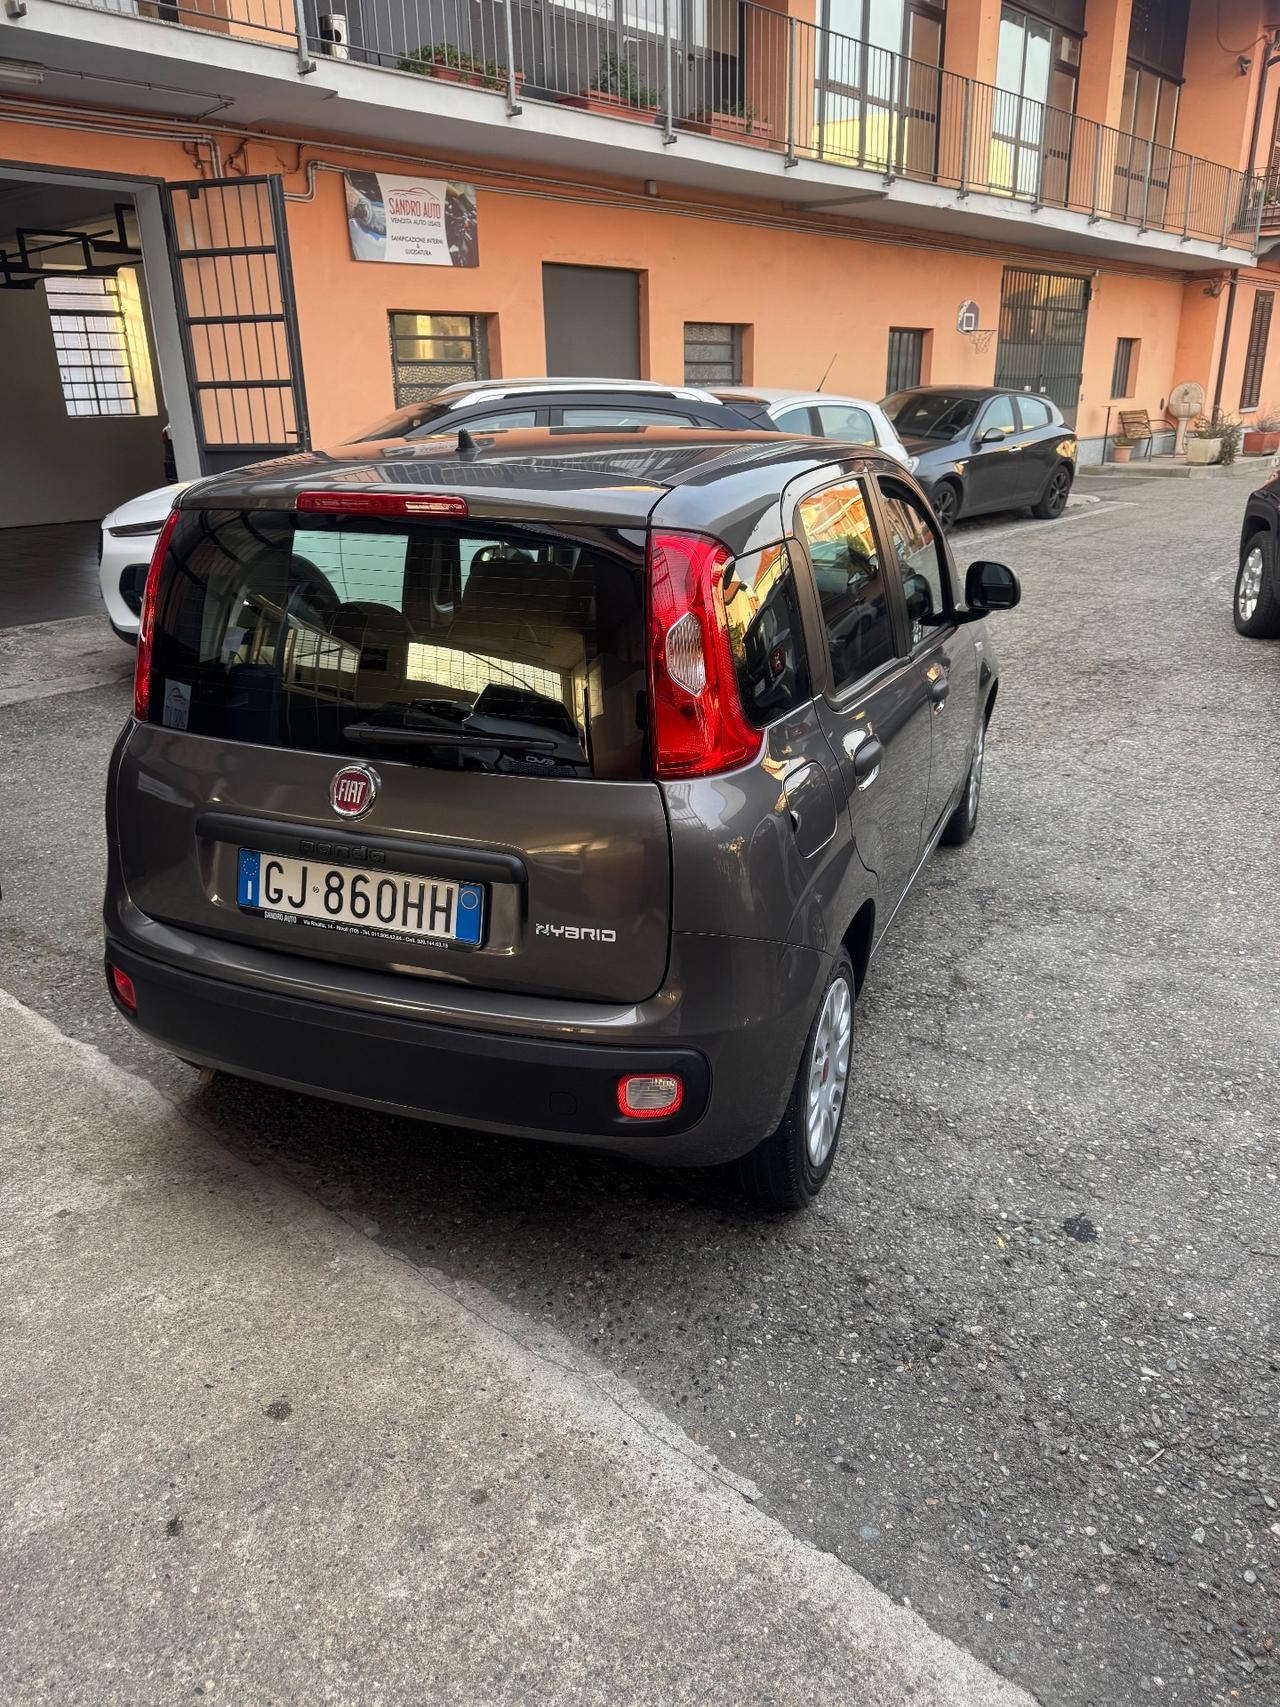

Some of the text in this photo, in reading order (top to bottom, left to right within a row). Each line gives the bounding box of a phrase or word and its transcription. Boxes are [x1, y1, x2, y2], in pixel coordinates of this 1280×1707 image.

[388, 197, 441, 219] SANDRO AUTO
[391, 217, 412, 225] VENDITA
[427, 220, 441, 228] USATE
[391, 235, 426, 243] SANIFICAZIONE
[337, 779, 366, 804] FIAT
[264, 860, 308, 909] GJ
[323, 870, 453, 934] 860HH
[264, 911, 284, 921] SANDRO
[283, 914, 297, 924] AUTO
[535, 922, 617, 942] HYBRID
